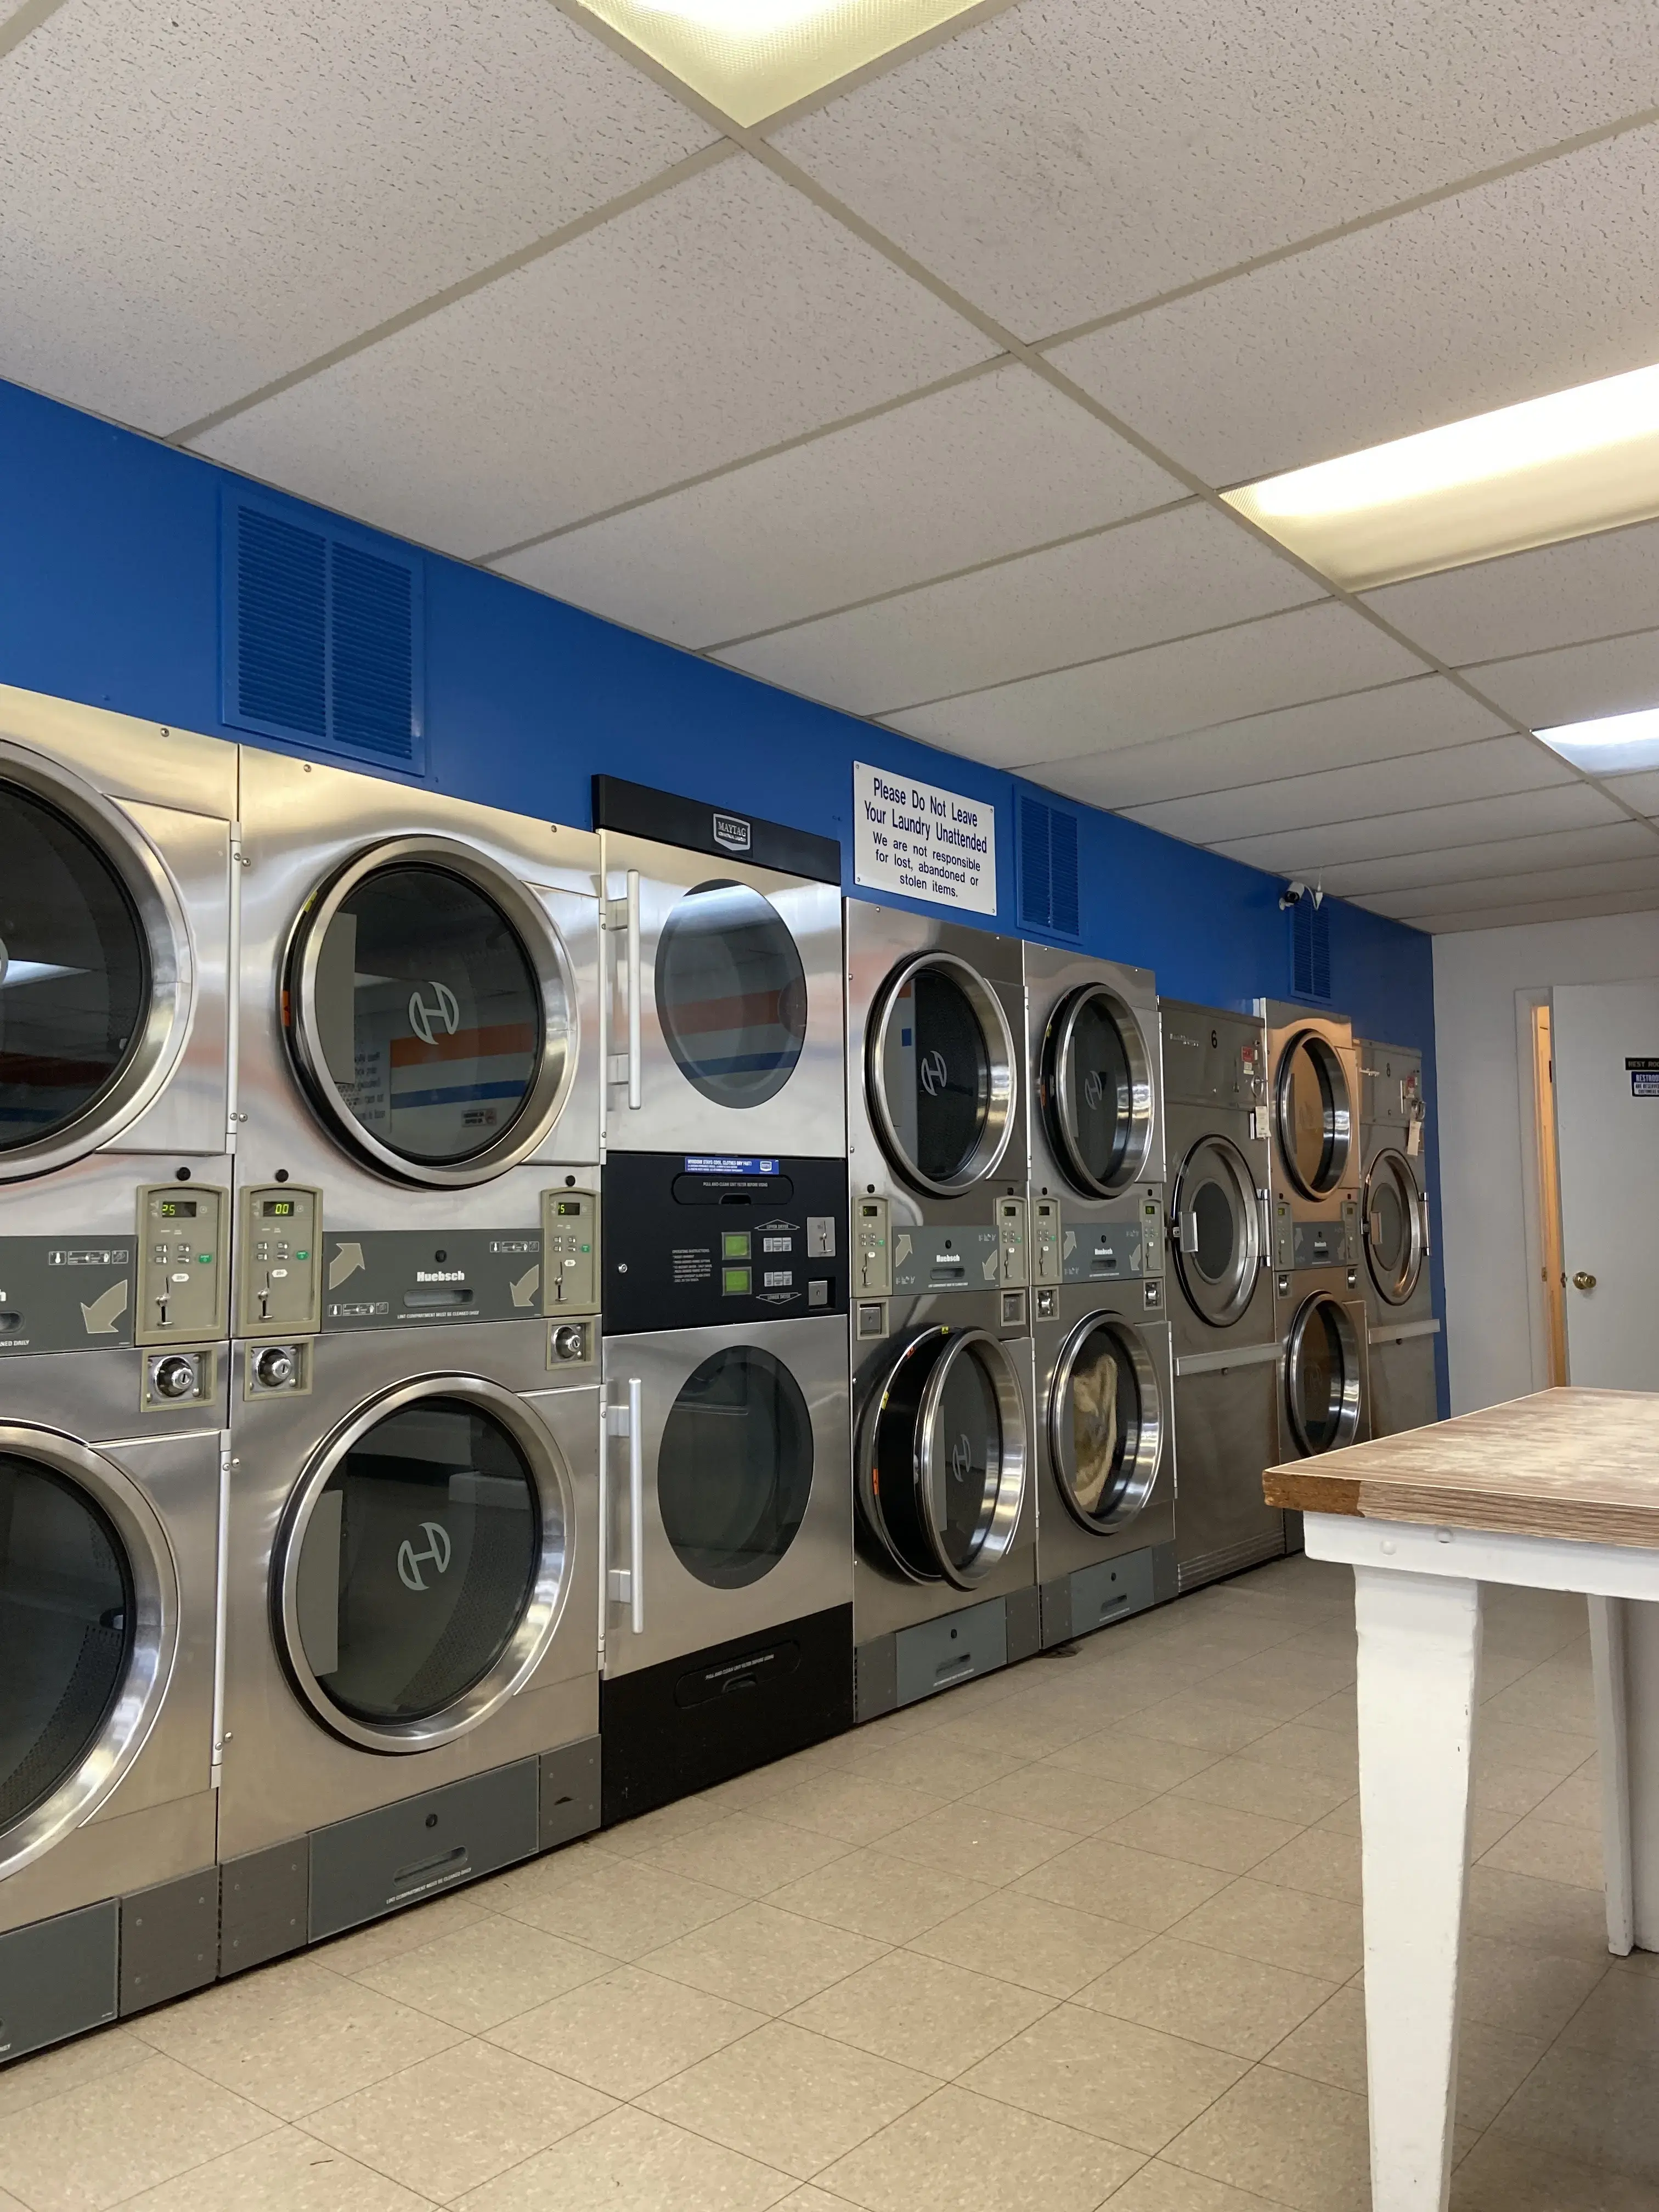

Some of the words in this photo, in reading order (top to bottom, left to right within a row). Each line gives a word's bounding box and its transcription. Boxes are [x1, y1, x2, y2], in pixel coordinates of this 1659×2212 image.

[873, 777, 906, 805] Please
[912, 789, 925, 811] Do
[930, 795, 946, 818] Not
[952, 802, 978, 827] Leave
[718, 821, 746, 837] MAYTAG
[864, 800, 886, 825] Your
[892, 809, 930, 840] Laundry
[936, 822, 987, 854] Unattended
[873, 831, 888, 847] We
[893, 839, 907, 851] are
[913, 845, 928, 857] not
[933, 851, 980, 872] responsible
[876, 849, 889, 863] for
[894, 854, 913, 871] lost,
[918, 862, 965, 883] abandoned
[970, 877, 979, 887] or
[900, 874, 927, 889] stolen
[932, 879, 958, 898] items.
[1211, 1030, 1218, 1049] 6
[417, 1271, 465, 1282] Huebsch
